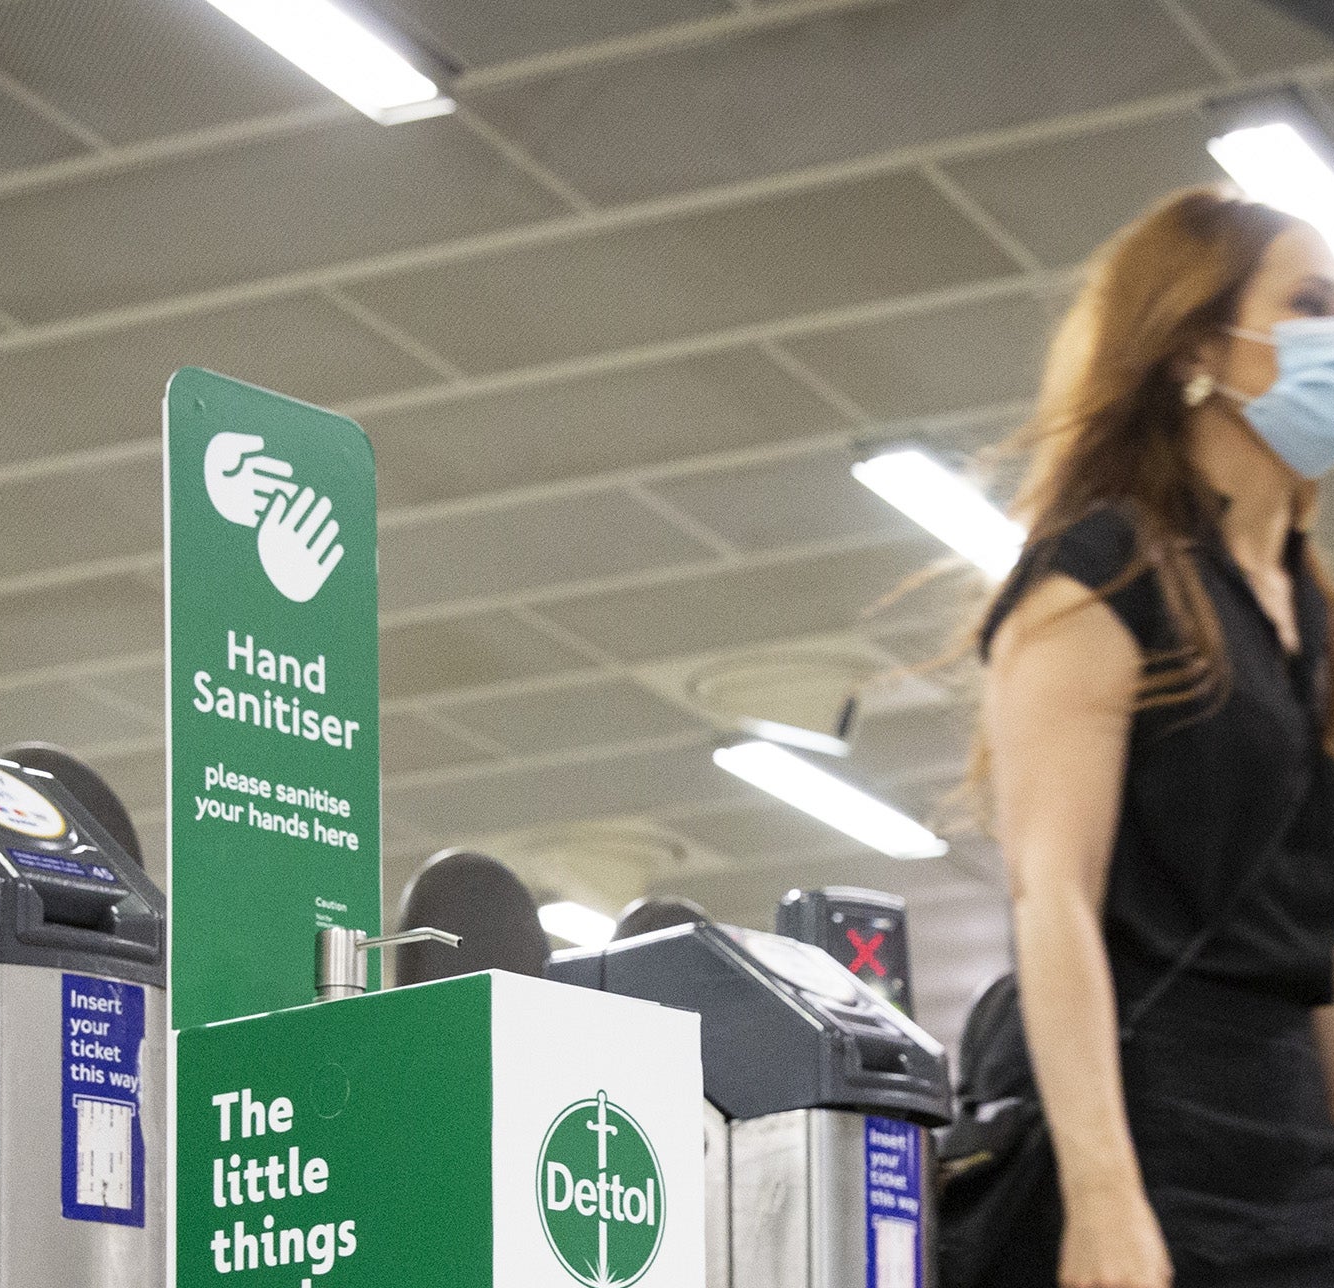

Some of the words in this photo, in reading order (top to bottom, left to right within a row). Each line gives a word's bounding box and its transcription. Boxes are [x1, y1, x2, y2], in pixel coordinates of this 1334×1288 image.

[228, 630, 325, 694] Hand
[194, 671, 359, 749] Sanitiser
[205, 763, 271, 798] please
[276, 784, 350, 817] sanitise
[195, 796, 244, 822] your
[249, 802, 309, 839] hands
[314, 818, 358, 850] here
[70, 1018, 110, 1036] your
[71, 990, 122, 1015] Insert
[71, 1039, 121, 1062] ticket
[70, 1064, 104, 1083] this
[108, 1071, 140, 1094] way
[212, 1089, 293, 1141] The
[214, 1147, 328, 1207] little
[547, 1161, 654, 1225] Dettol
[211, 1215, 356, 1275] things
